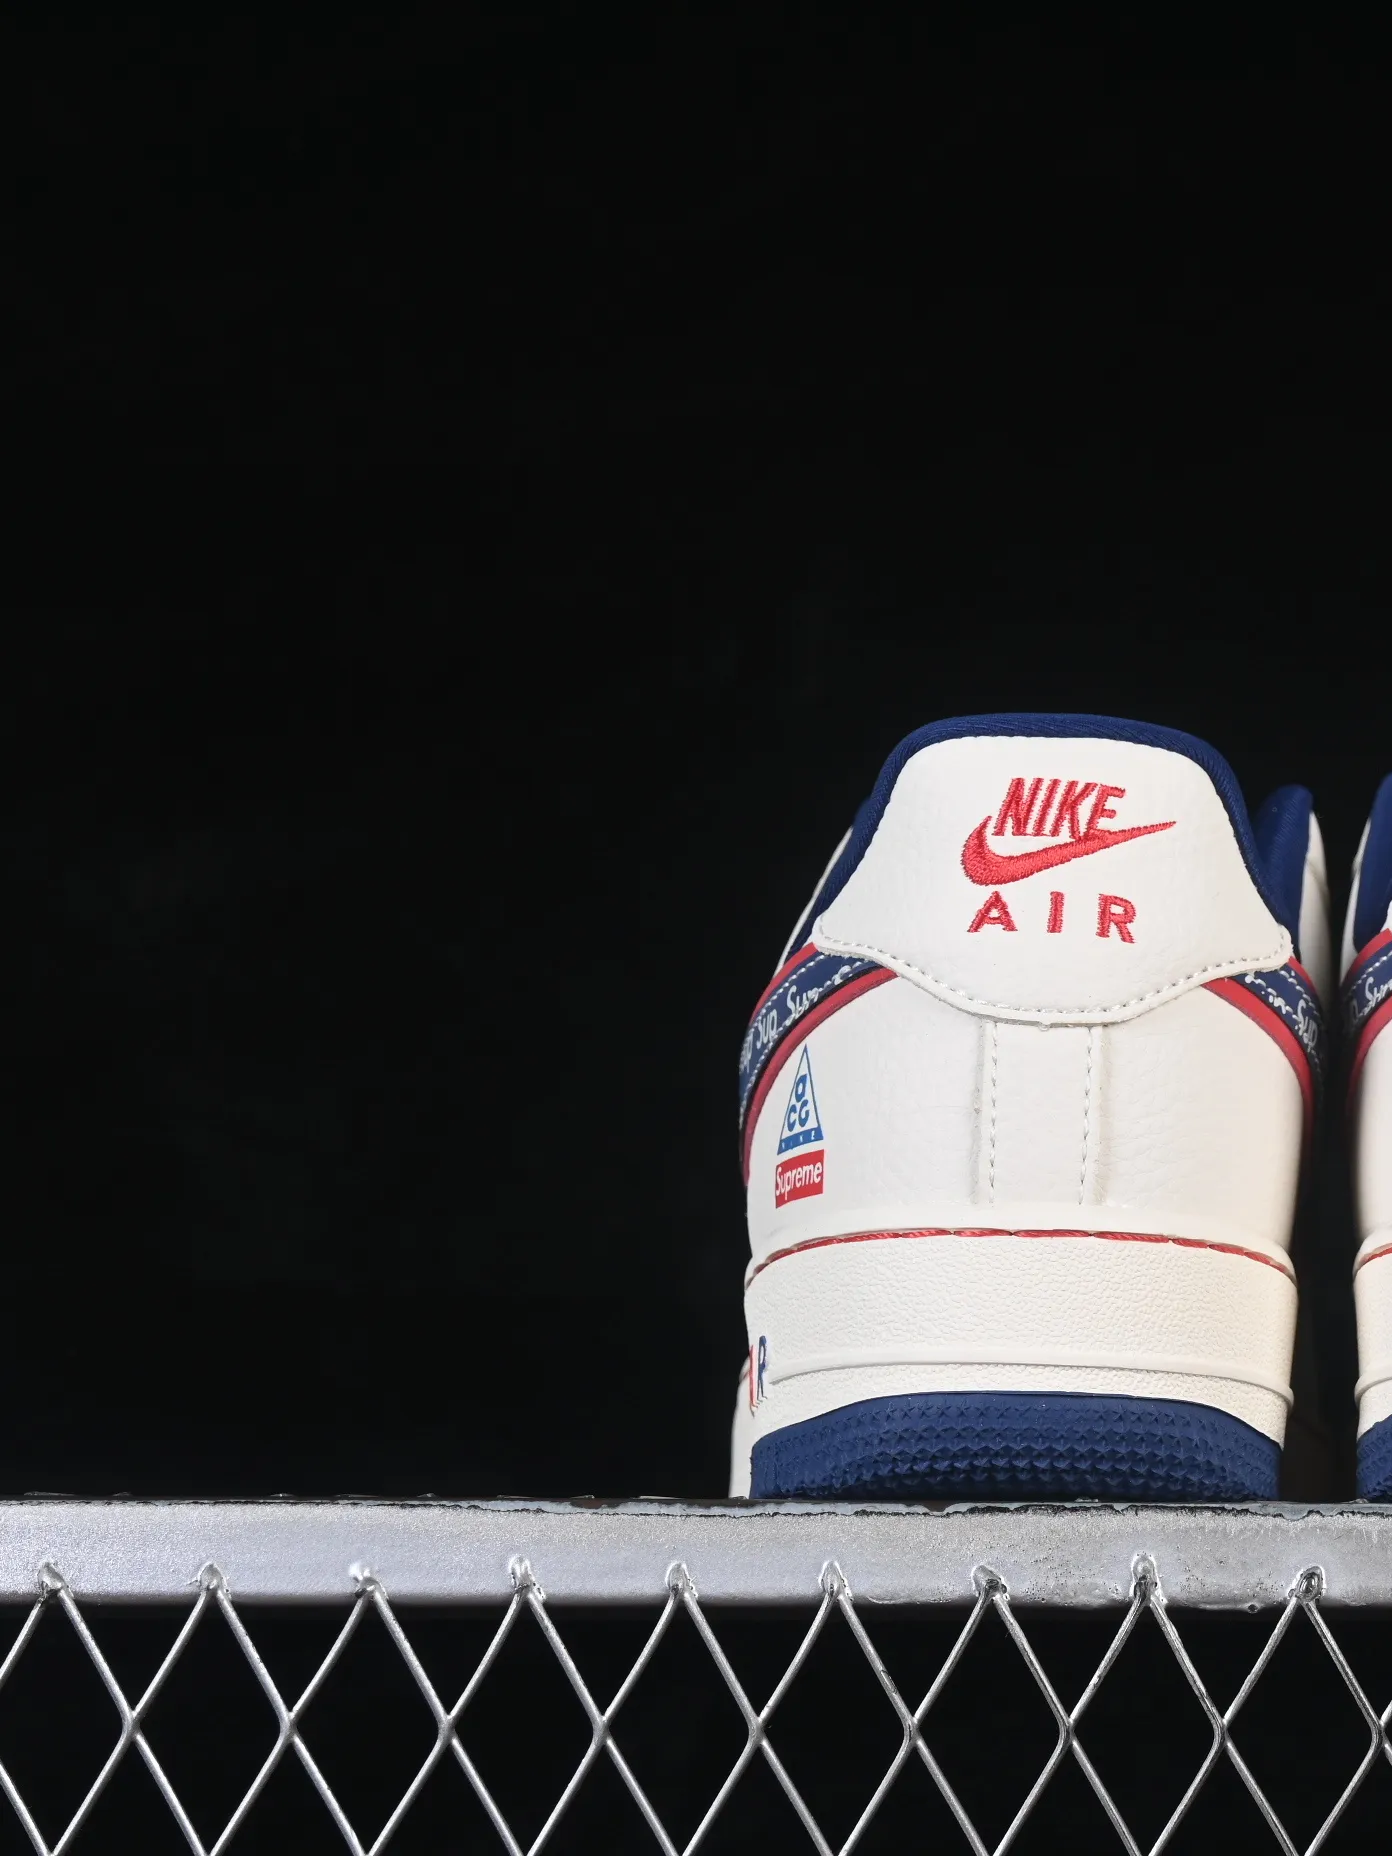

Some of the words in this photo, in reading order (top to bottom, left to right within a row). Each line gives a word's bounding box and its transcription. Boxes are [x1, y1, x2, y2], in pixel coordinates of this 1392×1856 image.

[991, 777, 1126, 840] NIKE
[967, 890, 1137, 943] AIR
[776, 1161, 823, 1201] Supreme
